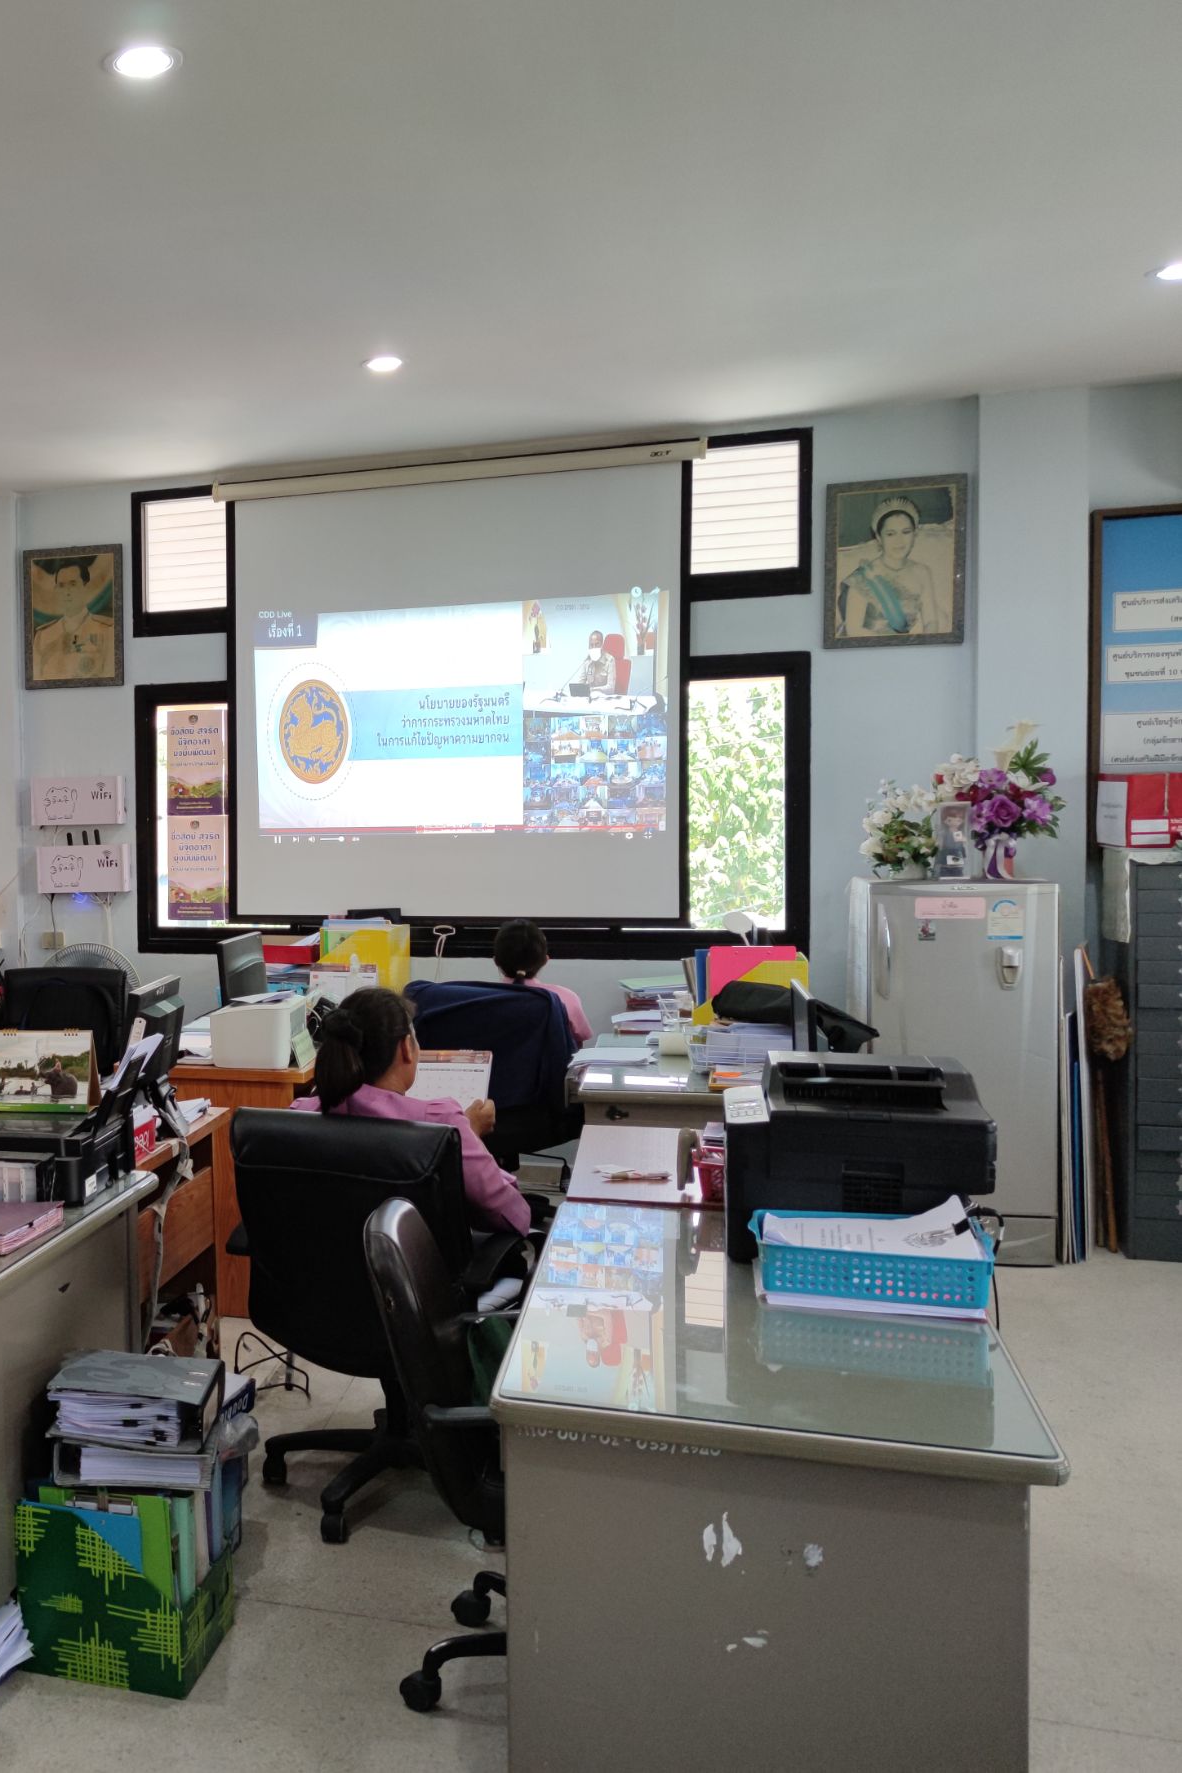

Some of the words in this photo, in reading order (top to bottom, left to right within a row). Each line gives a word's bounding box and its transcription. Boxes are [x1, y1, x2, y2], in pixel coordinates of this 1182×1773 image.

[258, 610, 275, 619] CDD
[276, 610, 292, 618] Live
[268, 619, 294, 638] เรื่องที่
[297, 624, 303, 637] 1
[419, 692, 510, 712] นโยบายของรัฐมนตรี
[401, 710, 510, 729] ว่าการกระทรวงมหาดไทย
[376, 732, 510, 749] ในการแก้ไขปัญหาความยากจน
